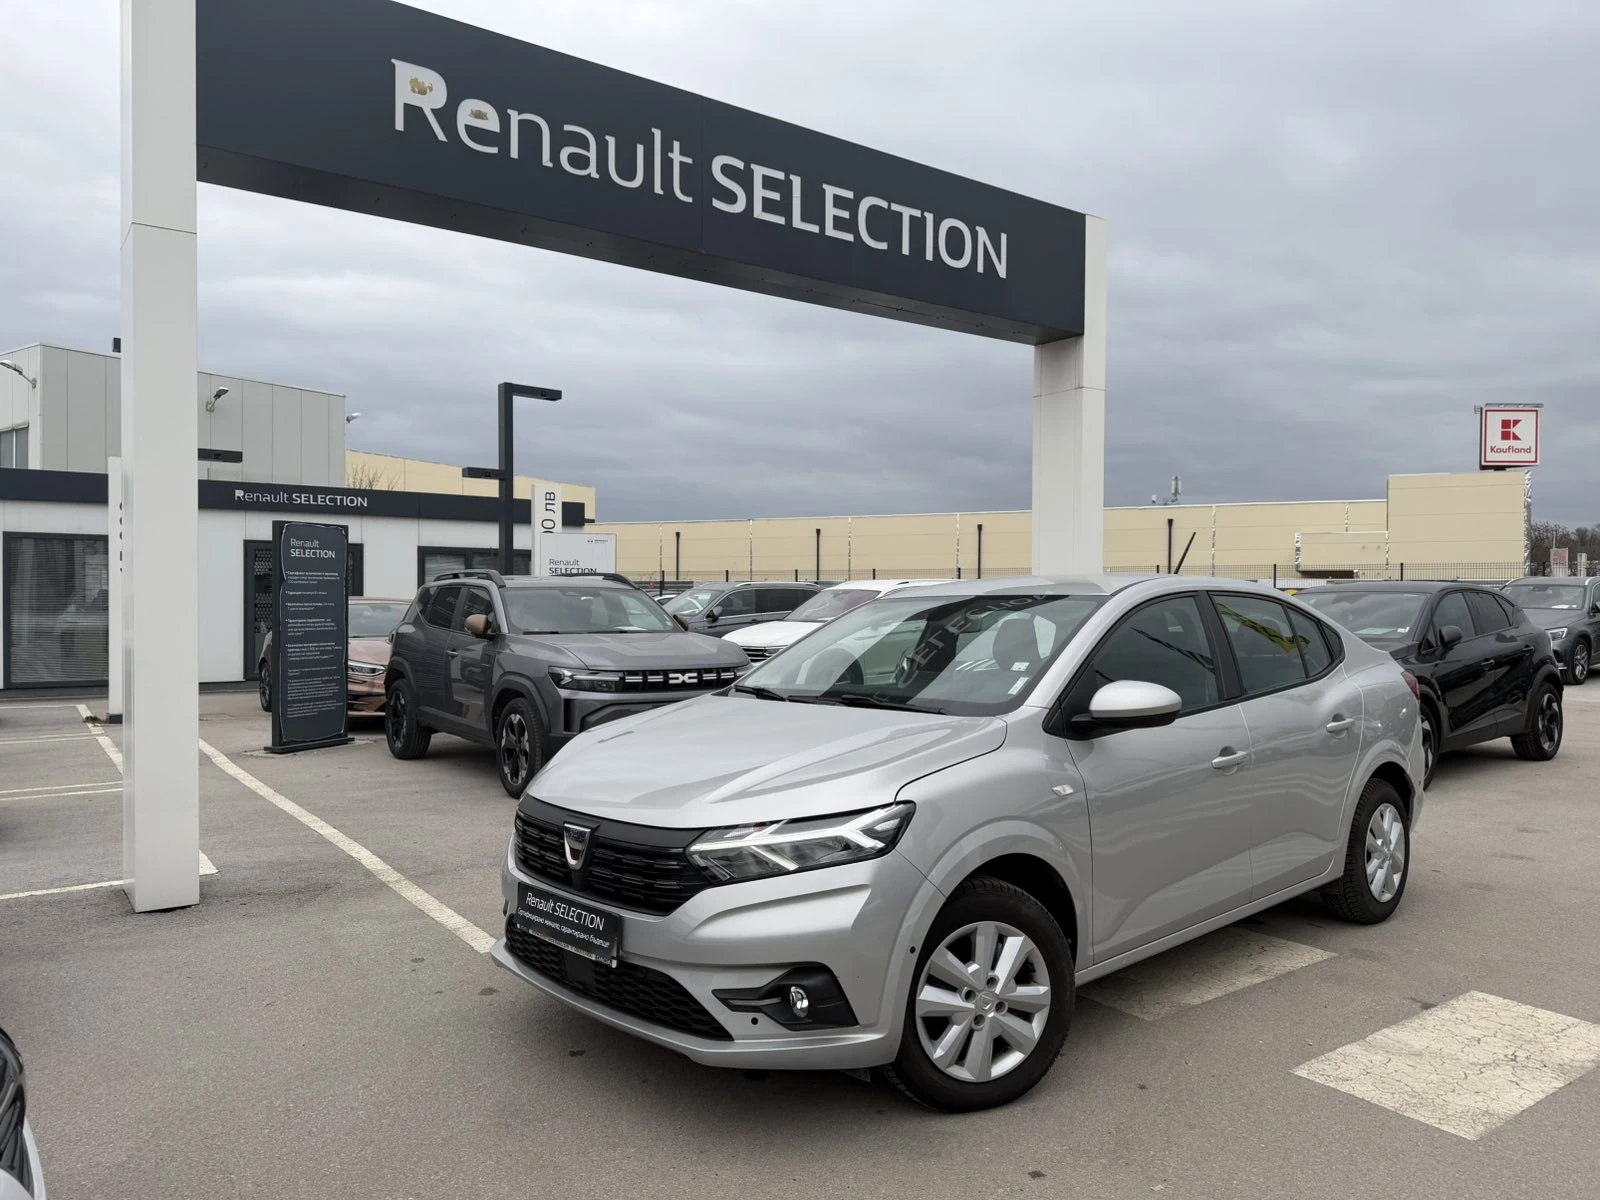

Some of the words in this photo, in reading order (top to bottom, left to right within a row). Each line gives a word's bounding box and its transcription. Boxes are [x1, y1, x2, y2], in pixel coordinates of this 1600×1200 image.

[391, 58, 693, 203] Renault
[710, 154, 1008, 279] SELECTION
[1490, 445, 1532, 454] Kaufland
[234, 489, 289, 503] Renault
[292, 493, 368, 507] SELECTION
[290, 538, 320, 548] Renault
[290, 548, 336, 559] SELECTION
[548, 558, 580, 566] Renault
[525, 892, 554, 913] Renault
[554, 902, 604, 931] SELECTION
